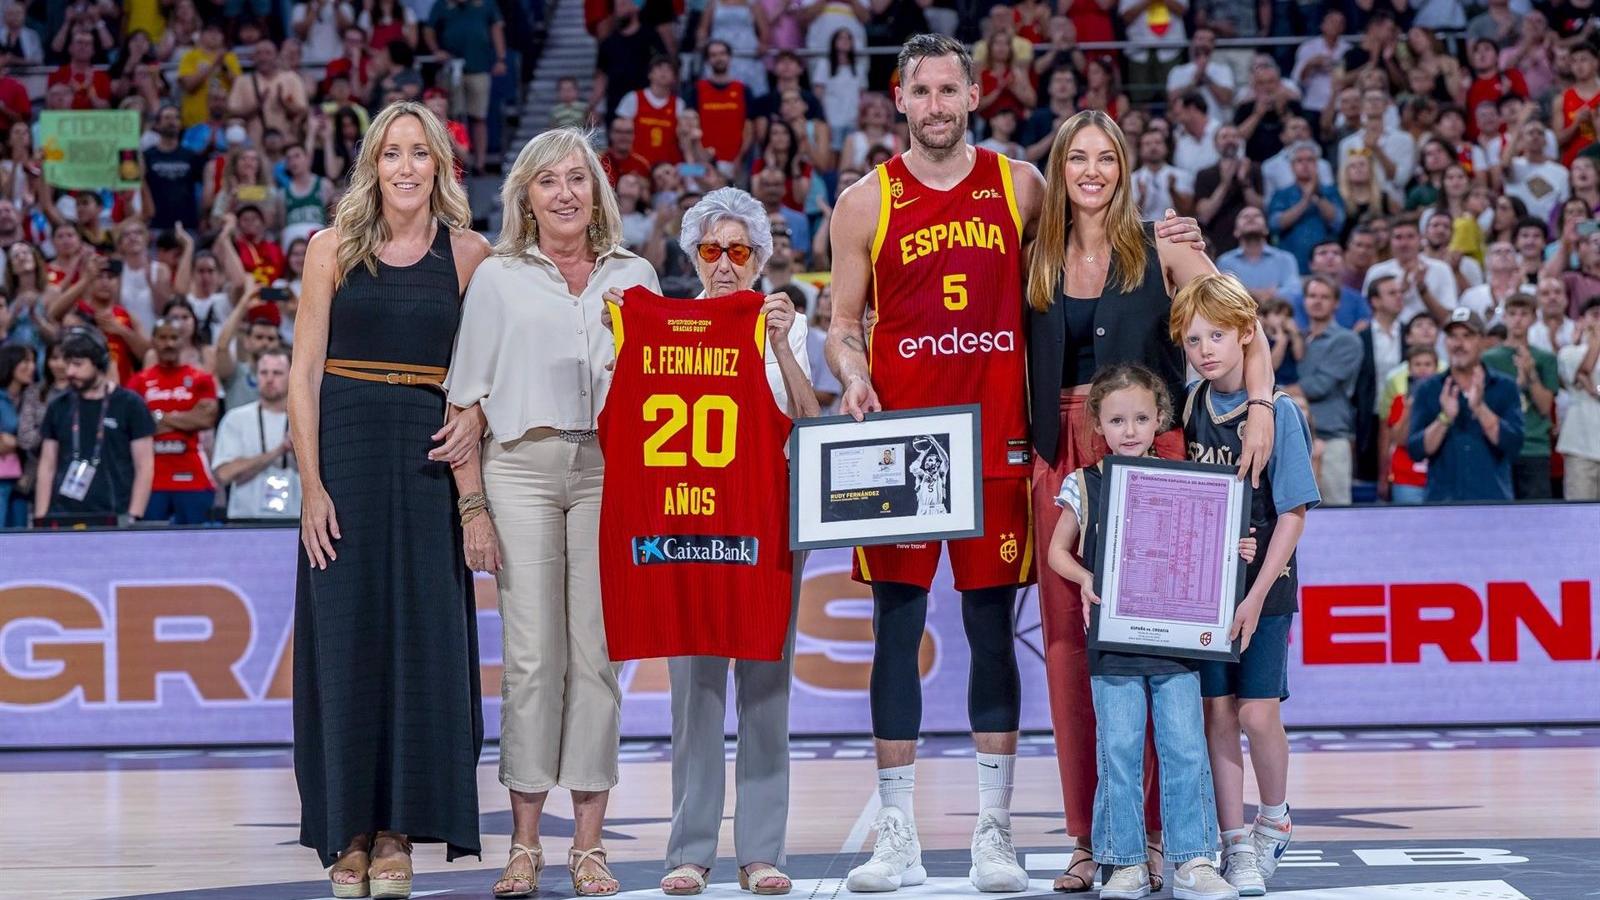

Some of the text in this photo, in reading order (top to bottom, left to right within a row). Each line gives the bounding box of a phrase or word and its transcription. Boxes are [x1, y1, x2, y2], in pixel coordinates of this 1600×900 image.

[900, 216, 1006, 265] ESPAÑA
[943, 273, 968, 311] 5
[643, 341, 740, 377] R. FERNÁNDEZ
[899, 327, 1014, 358] endesa
[643, 394, 738, 468] 20
[664, 482, 715, 515] AÑOS
[663, 538, 751, 562] CaixaBank
[1289, 579, 1600, 665] ERN
